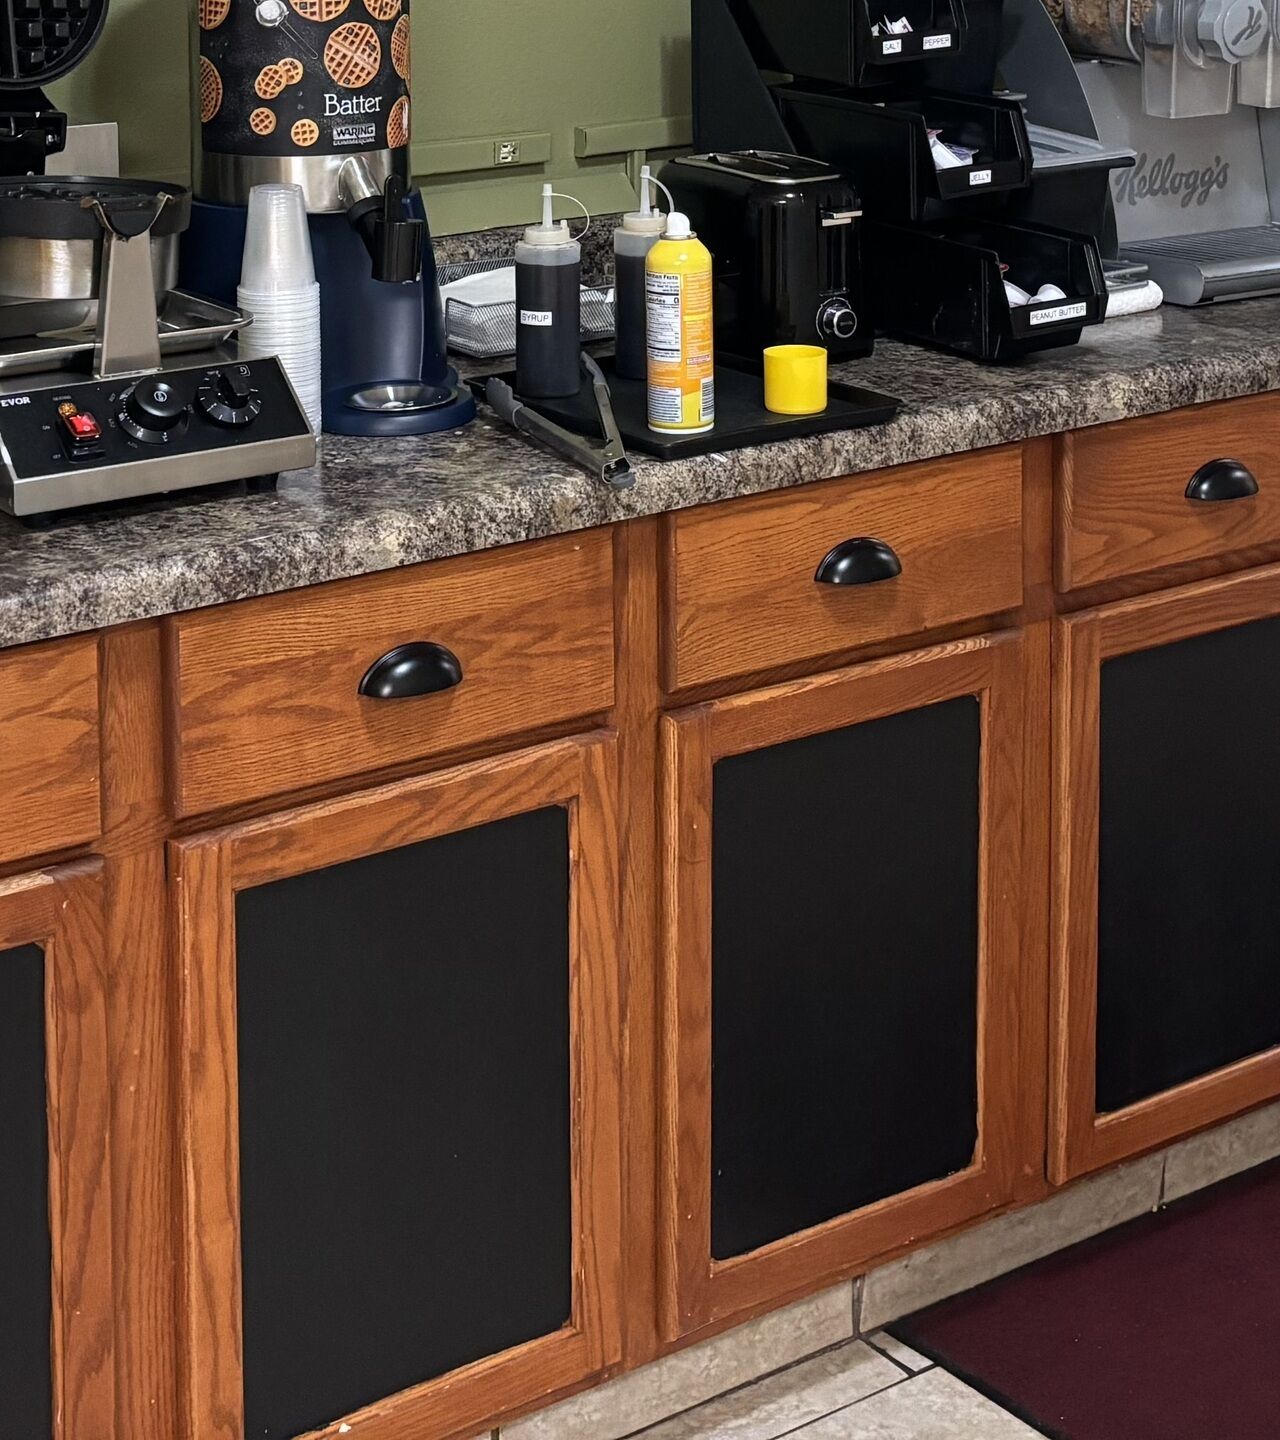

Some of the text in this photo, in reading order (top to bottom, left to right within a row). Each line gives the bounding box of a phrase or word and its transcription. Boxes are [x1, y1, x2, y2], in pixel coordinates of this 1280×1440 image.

[884, 42, 899, 51] SALT
[924, 37, 949, 46] PEPPER
[324, 94, 382, 116] Batter
[335, 125, 374, 138] WARING
[971, 174, 989, 182] JELLY
[1115, 152, 1230, 208] Kellogg's
[522, 313, 549, 322] SYRUP
[1032, 305, 1085, 320] PEANUT BUTTER
